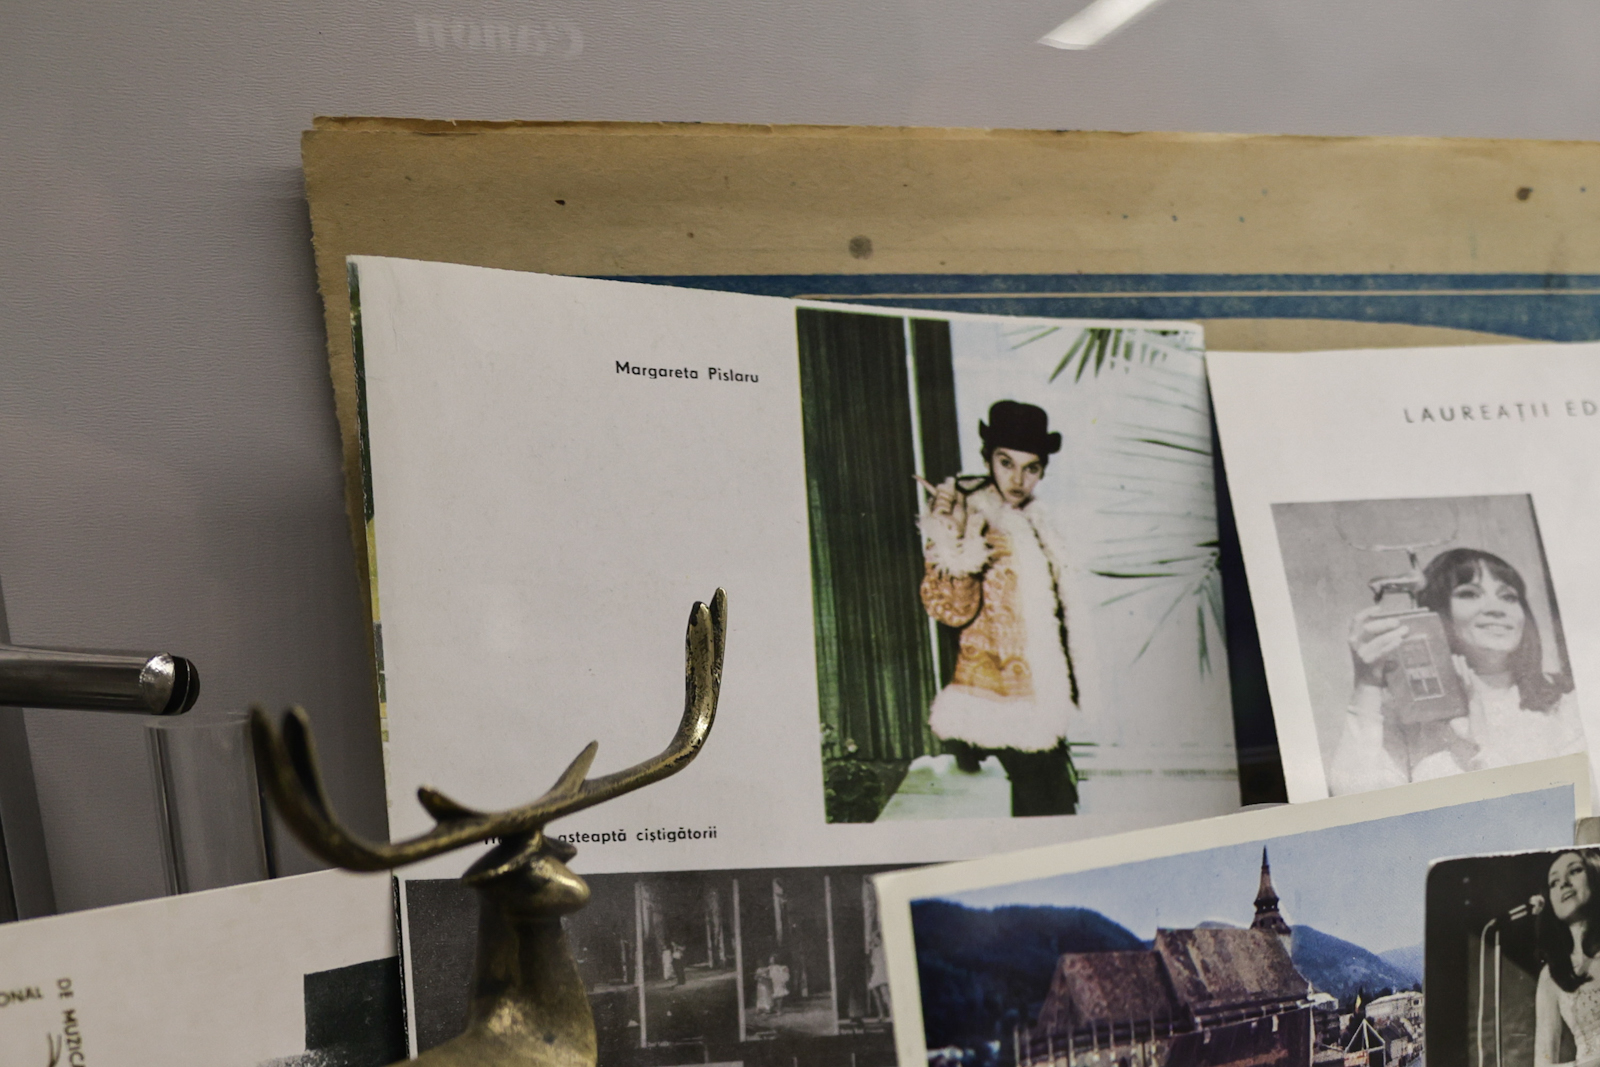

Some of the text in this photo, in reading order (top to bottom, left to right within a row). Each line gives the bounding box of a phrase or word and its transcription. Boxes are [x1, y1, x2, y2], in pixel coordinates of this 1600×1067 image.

[615, 360, 759, 383] Margareta Pislaru
[56, 977, 74, 999] DE
